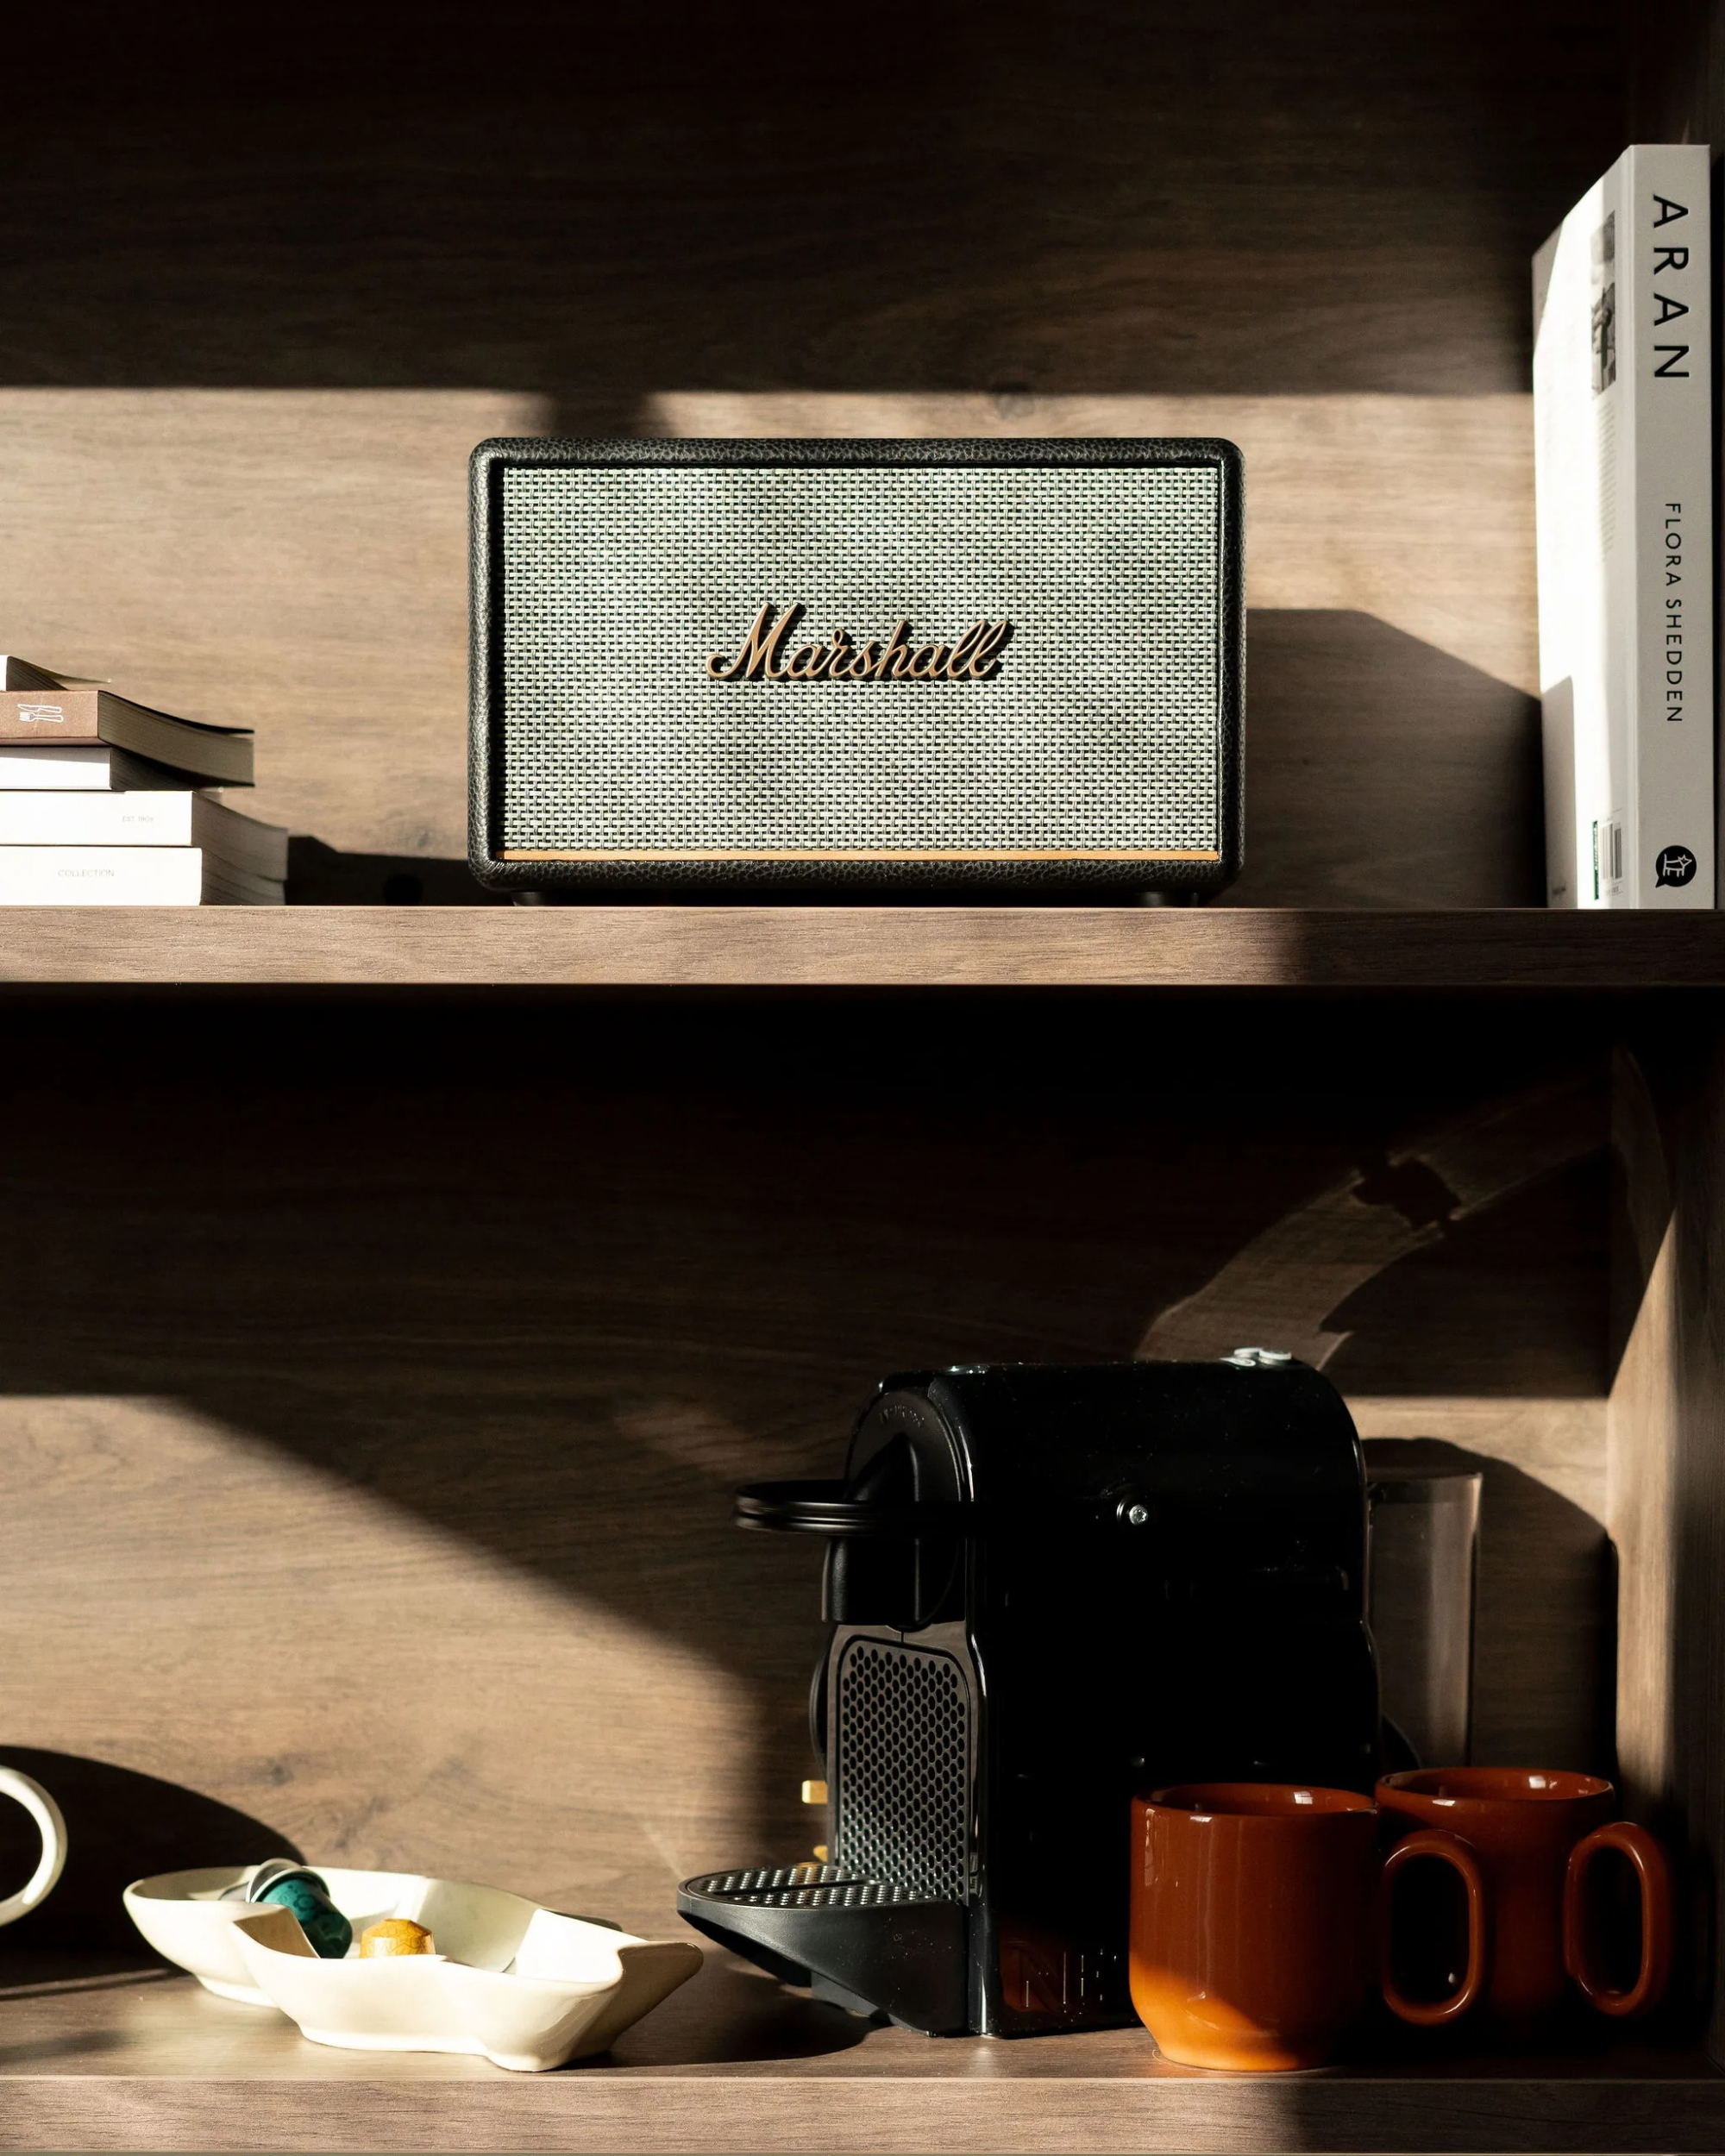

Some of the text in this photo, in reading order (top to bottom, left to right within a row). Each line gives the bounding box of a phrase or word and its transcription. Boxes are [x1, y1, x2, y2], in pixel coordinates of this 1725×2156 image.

[1653, 195, 1690, 378] ARAN
[705, 602, 1008, 680] Marshall
[1665, 503, 1683, 722] FLORA SHEDDEN
